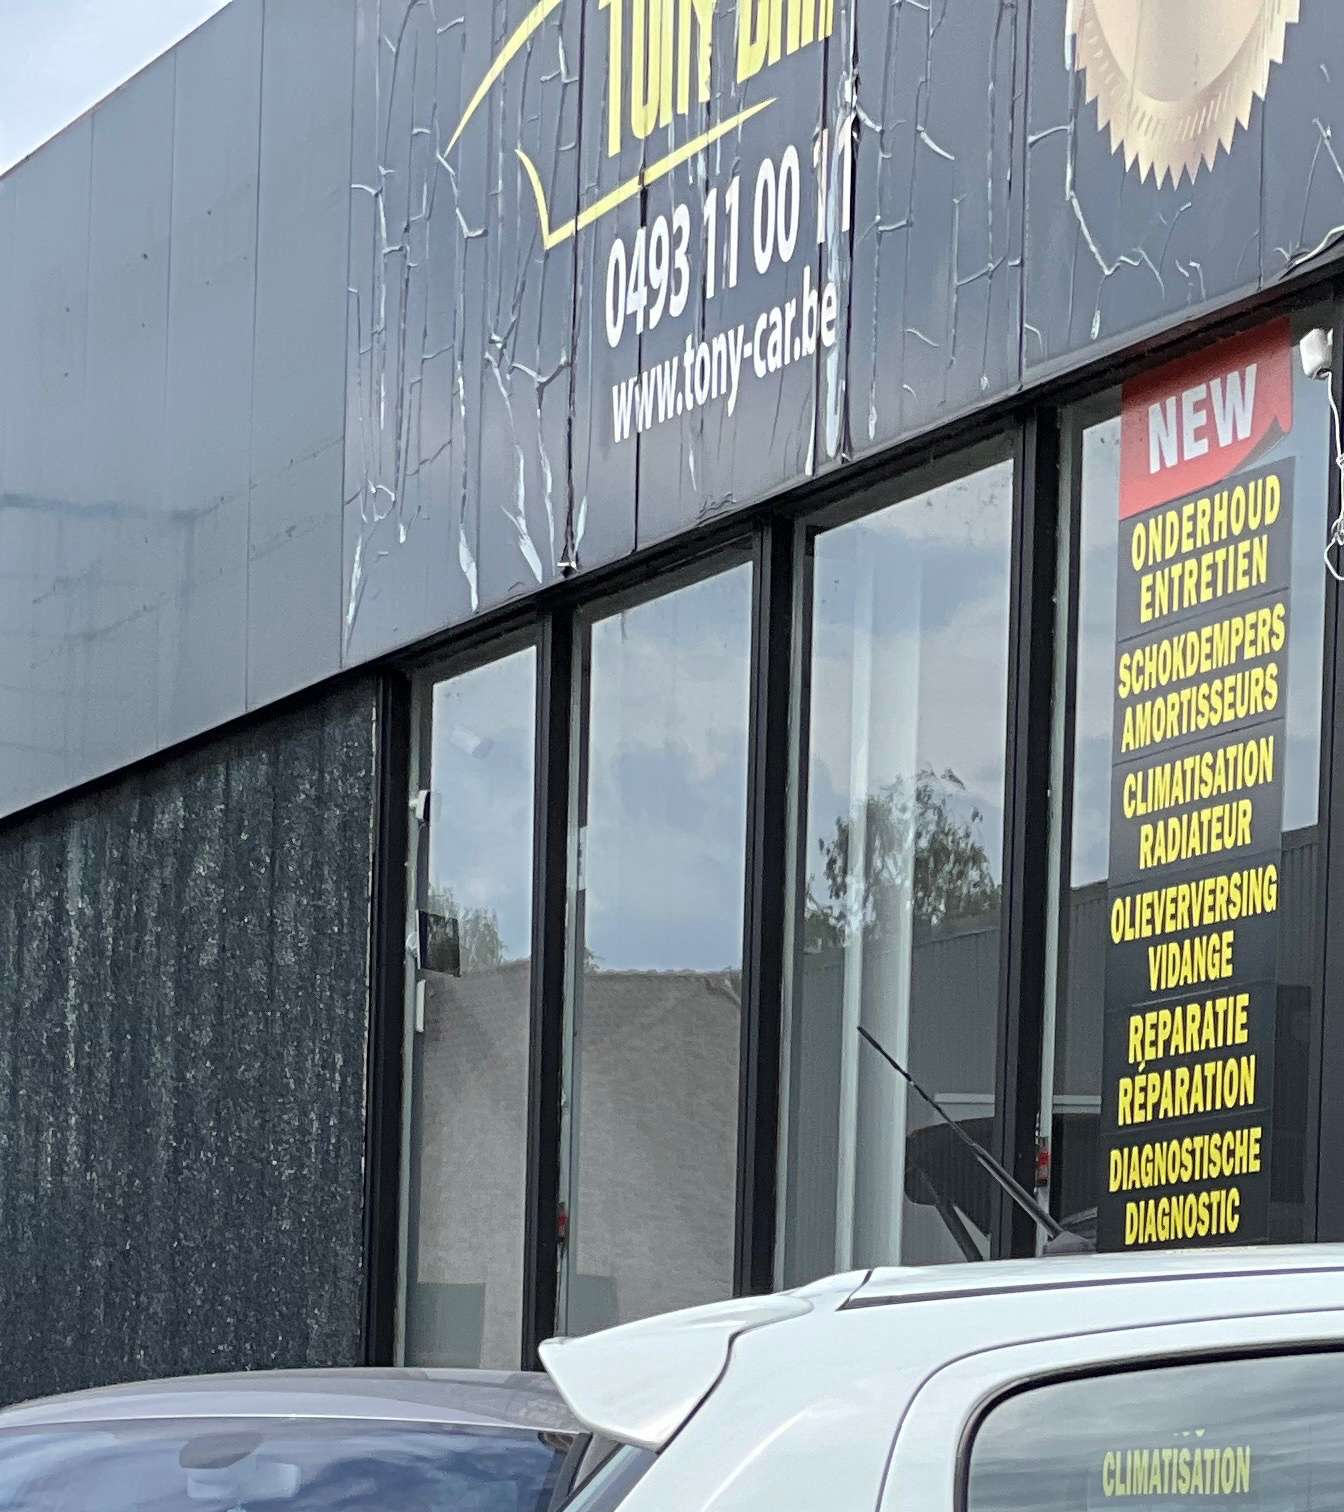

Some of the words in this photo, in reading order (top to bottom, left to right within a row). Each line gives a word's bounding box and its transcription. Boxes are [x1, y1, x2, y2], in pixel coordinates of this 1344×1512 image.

[605, 203, 691, 348] 0493
[703, 175, 741, 299] 11
[753, 145, 800, 274] 00
[612, 264, 838, 443] www.tony-car.be
[1148, 363, 1258, 474] NEW
[1132, 475, 1281, 571] ONDERHOUD
[1139, 534, 1269, 623] ENTRETIEN
[1118, 603, 1286, 699] SCHOKDEMPERS
[1121, 662, 1279, 752] AMORTISSEURS
[1123, 736, 1274, 819] CLIMATISATION
[1139, 799, 1252, 869] RADIATEUR
[1111, 864, 1278, 944] OLIEVERVERSING
[1148, 930, 1234, 991] VIDANGE
[1128, 993, 1249, 1064] REPARATIE
[1118, 1055, 1256, 1126] RÉPARATION
[1109, 1127, 1262, 1192] DIAGNOSTISCHE
[1125, 1188, 1240, 1245] DIAGNOSTIC
[1103, 1445, 1251, 1496] CLIMATISATION
